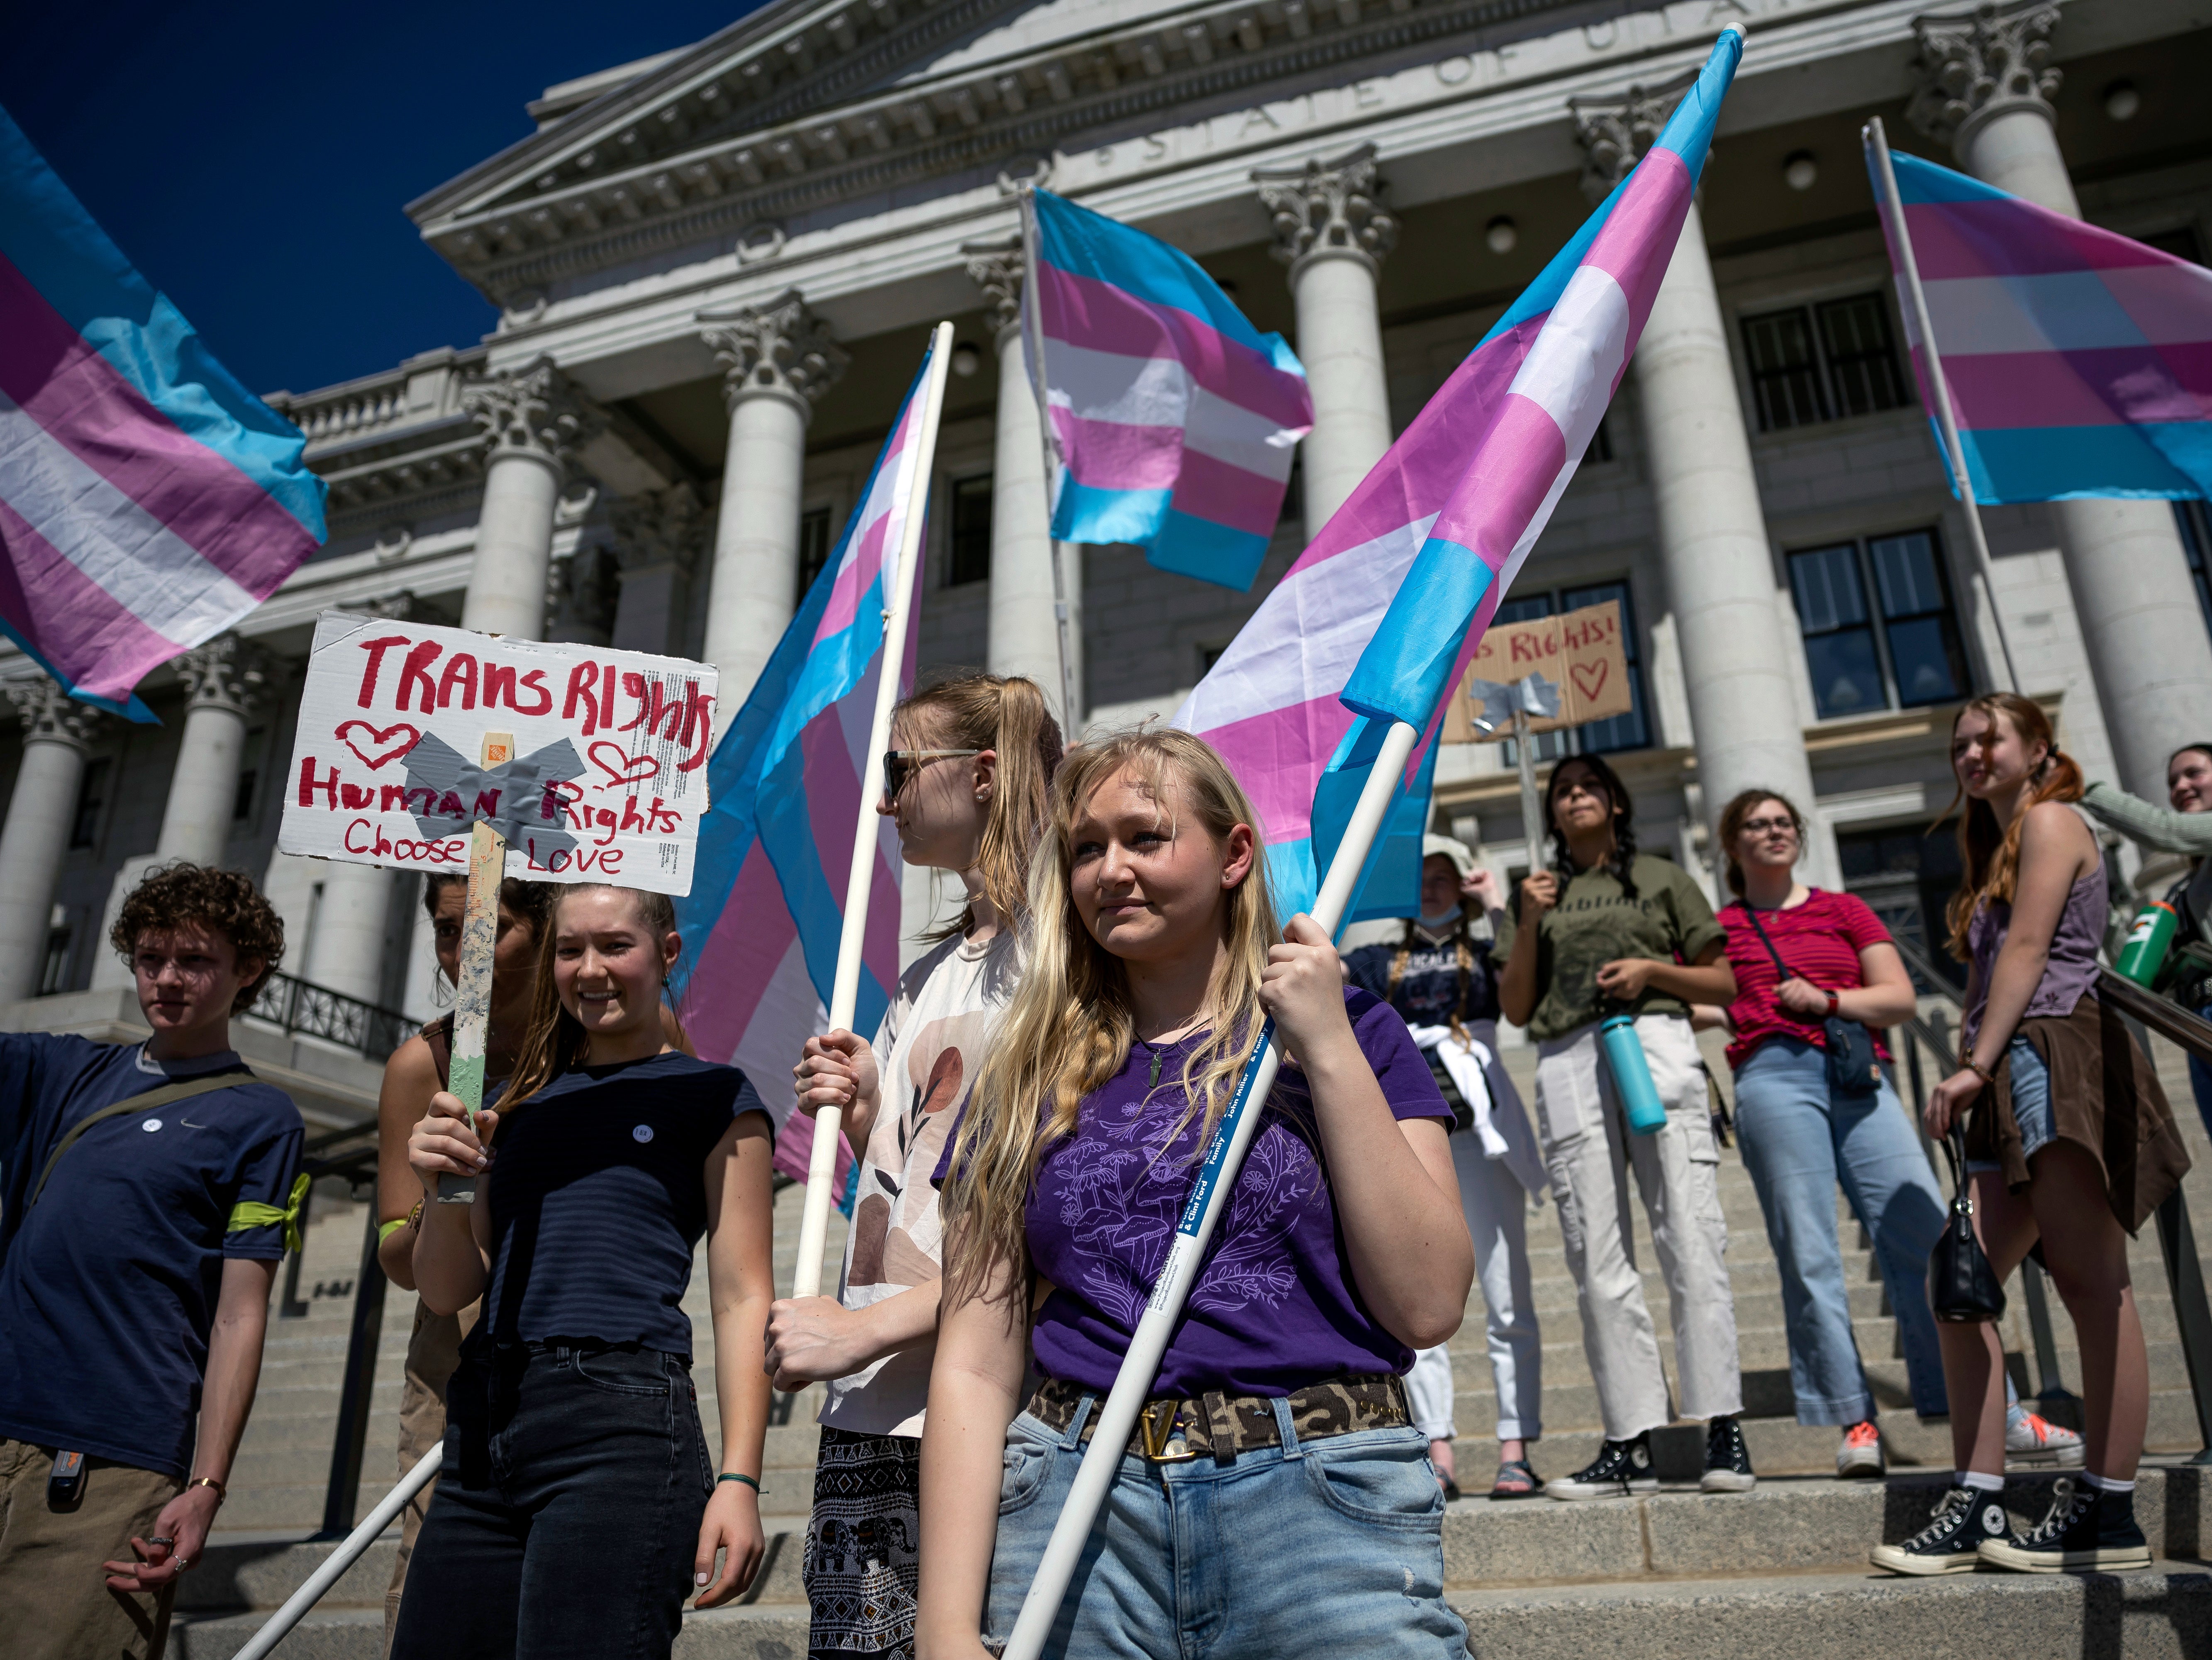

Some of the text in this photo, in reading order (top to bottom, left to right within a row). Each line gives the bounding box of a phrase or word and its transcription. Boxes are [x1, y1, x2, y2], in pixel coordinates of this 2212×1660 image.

[344, 818, 624, 874] Choose Love
[1227, 1098, 1239, 1119] John
[1236, 1073, 1249, 1096] Miller
[1209, 1136, 1225, 1165] Family
[1178, 1205, 1190, 1229] Bruce
[1188, 1201, 1200, 1221] Clint
[1196, 1180, 1208, 1200] Ford
